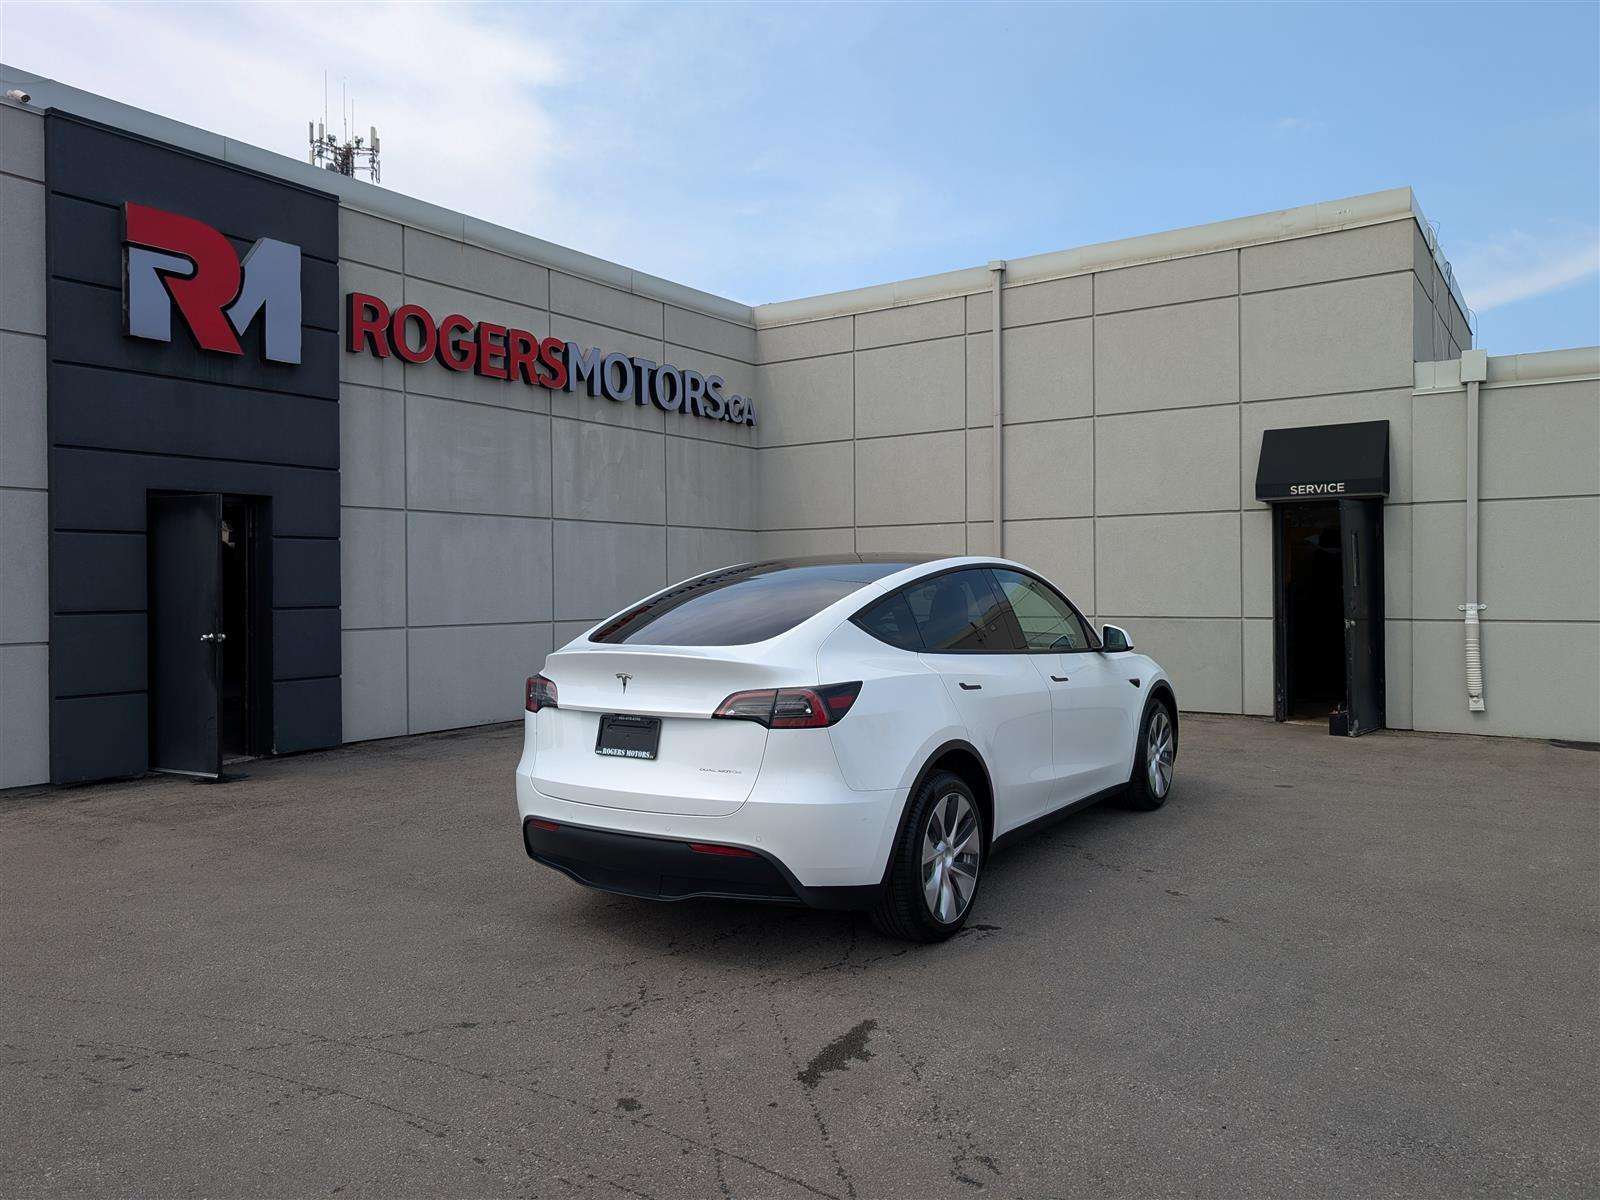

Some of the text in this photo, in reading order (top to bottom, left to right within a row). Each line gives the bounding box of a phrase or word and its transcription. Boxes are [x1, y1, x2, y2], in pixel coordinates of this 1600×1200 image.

[1290, 482, 1345, 495] SERVICE
[602, 747, 626, 757] ROGERS
[626, 748, 650, 760] MOTORS
